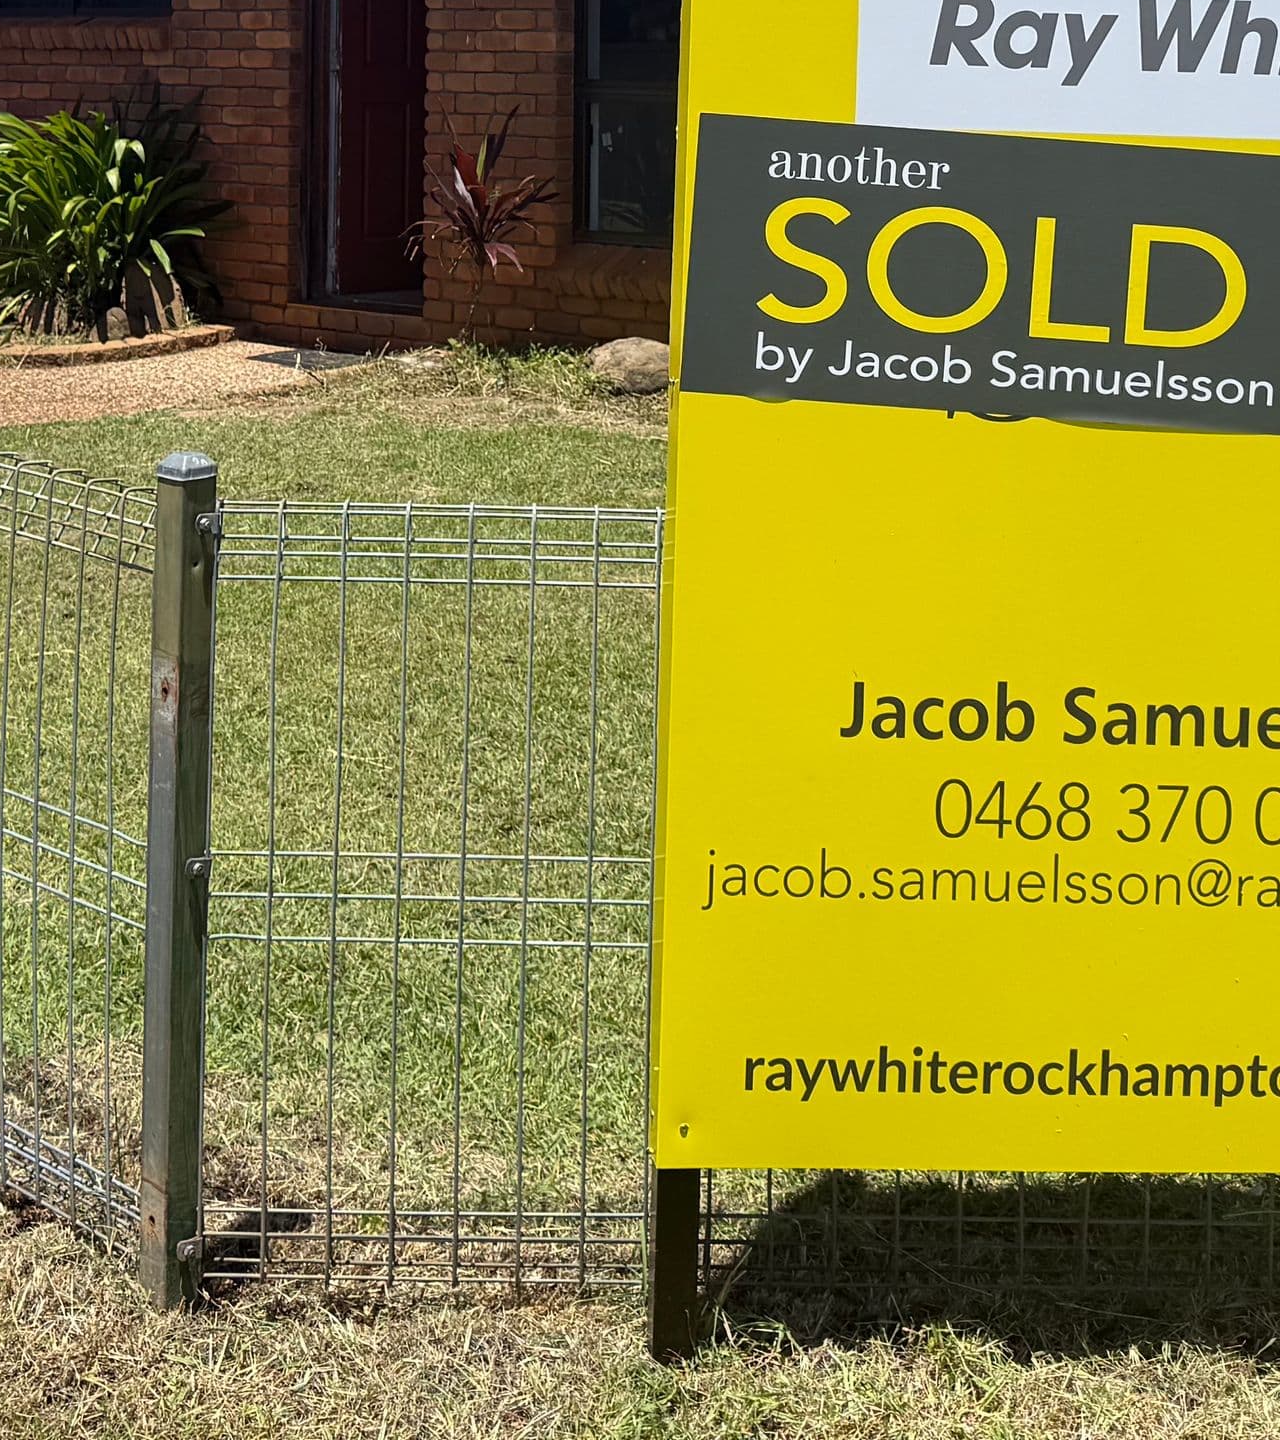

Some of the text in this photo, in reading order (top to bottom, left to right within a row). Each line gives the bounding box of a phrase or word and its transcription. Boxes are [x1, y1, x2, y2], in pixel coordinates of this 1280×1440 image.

[768, 144, 952, 192] another
[756, 196, 1248, 349] SOLD
[755, 330, 1275, 408] by Jacob Samuelsson
[839, 680, 1036, 744] Jacob
[934, 777, 1092, 843] 0468
[1116, 782, 1233, 847] 370
